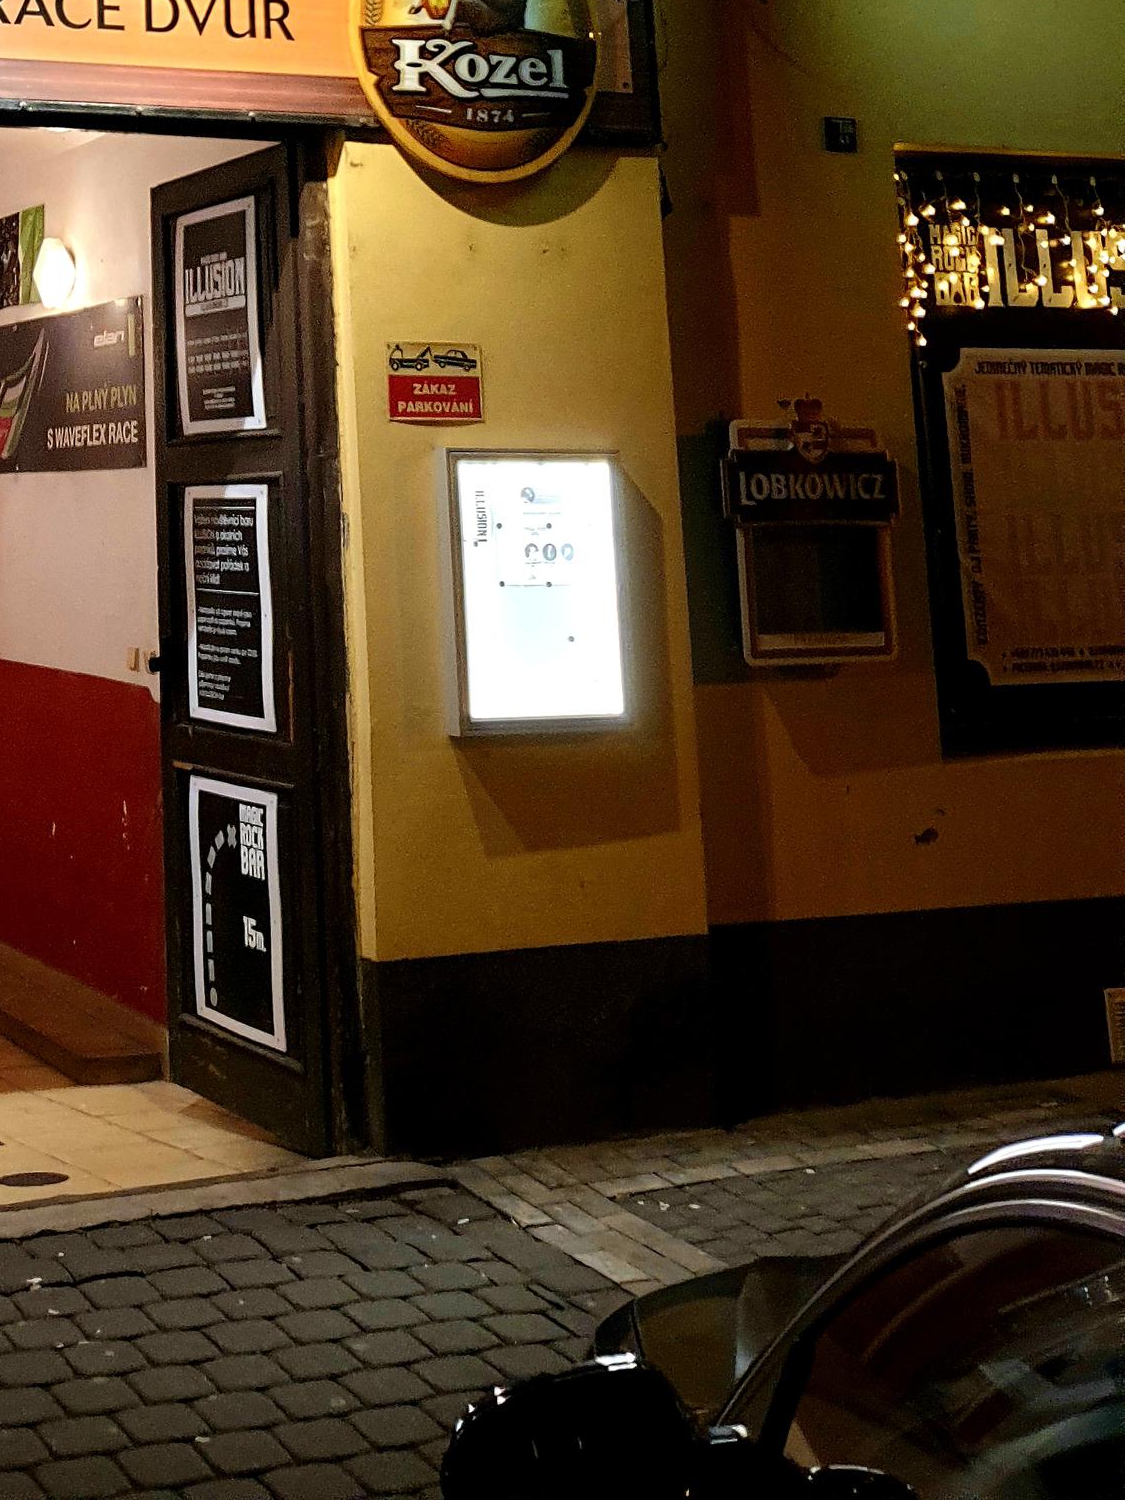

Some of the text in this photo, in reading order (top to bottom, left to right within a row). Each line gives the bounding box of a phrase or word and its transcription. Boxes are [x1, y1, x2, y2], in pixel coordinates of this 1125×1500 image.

[391, 38, 570, 99] Kozel
[466, 108, 515, 123] 1874
[185, 257, 246, 304] ILLUSION
[934, 272, 981, 306] BAR
[93, 328, 125, 348] elan
[66, 384, 137, 414] NA PLNÝ PLYN
[412, 380, 457, 396] ZÁKAZ
[397, 399, 474, 414] PARKOVÁNÍ
[46, 420, 139, 449] S WAVEFLEX RACE
[739, 470, 888, 506] LOBKOWICZ
[240, 822, 264, 851] ROCK
[240, 846, 266, 881] BAR
